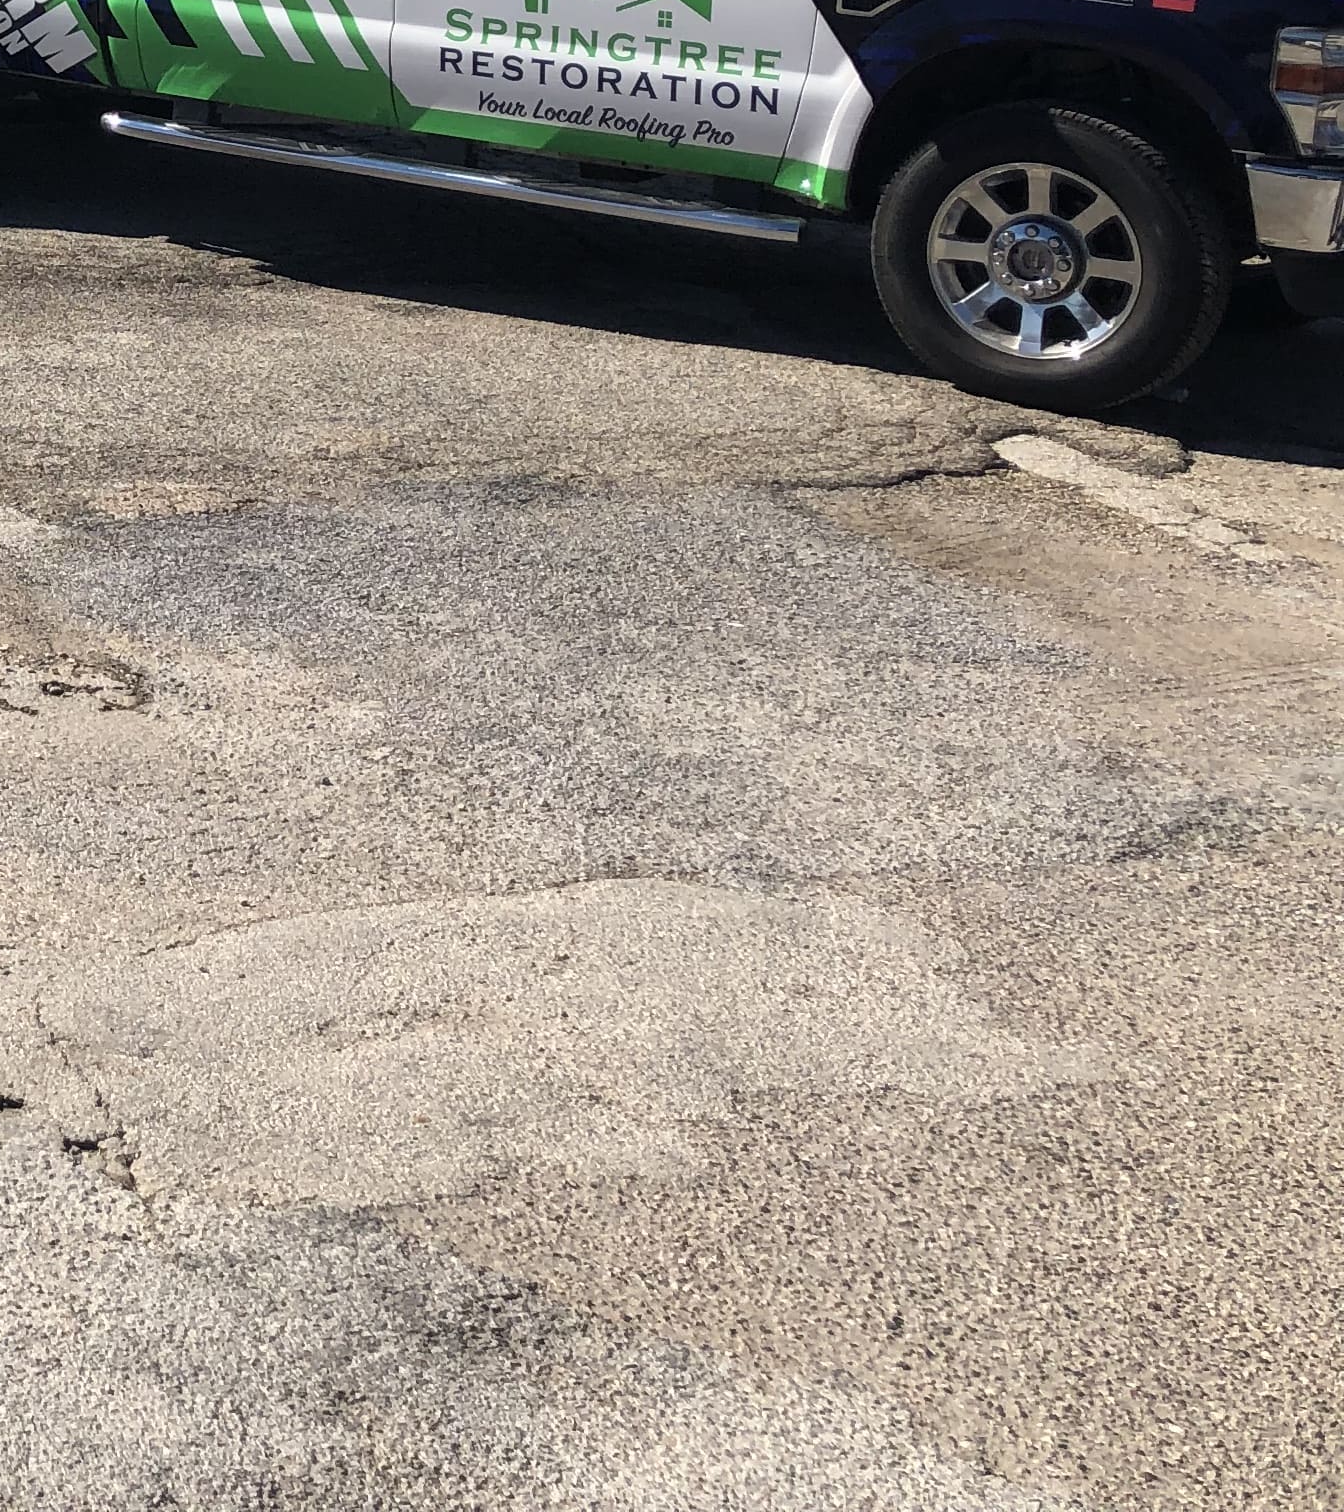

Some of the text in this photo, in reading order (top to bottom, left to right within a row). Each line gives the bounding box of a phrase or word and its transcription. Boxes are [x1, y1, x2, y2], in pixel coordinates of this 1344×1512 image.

[444, 7, 784, 82] SPRINGTREE
[438, 45, 781, 116] RESTORATION
[476, 90, 735, 149] Your Local Roofing Pro
